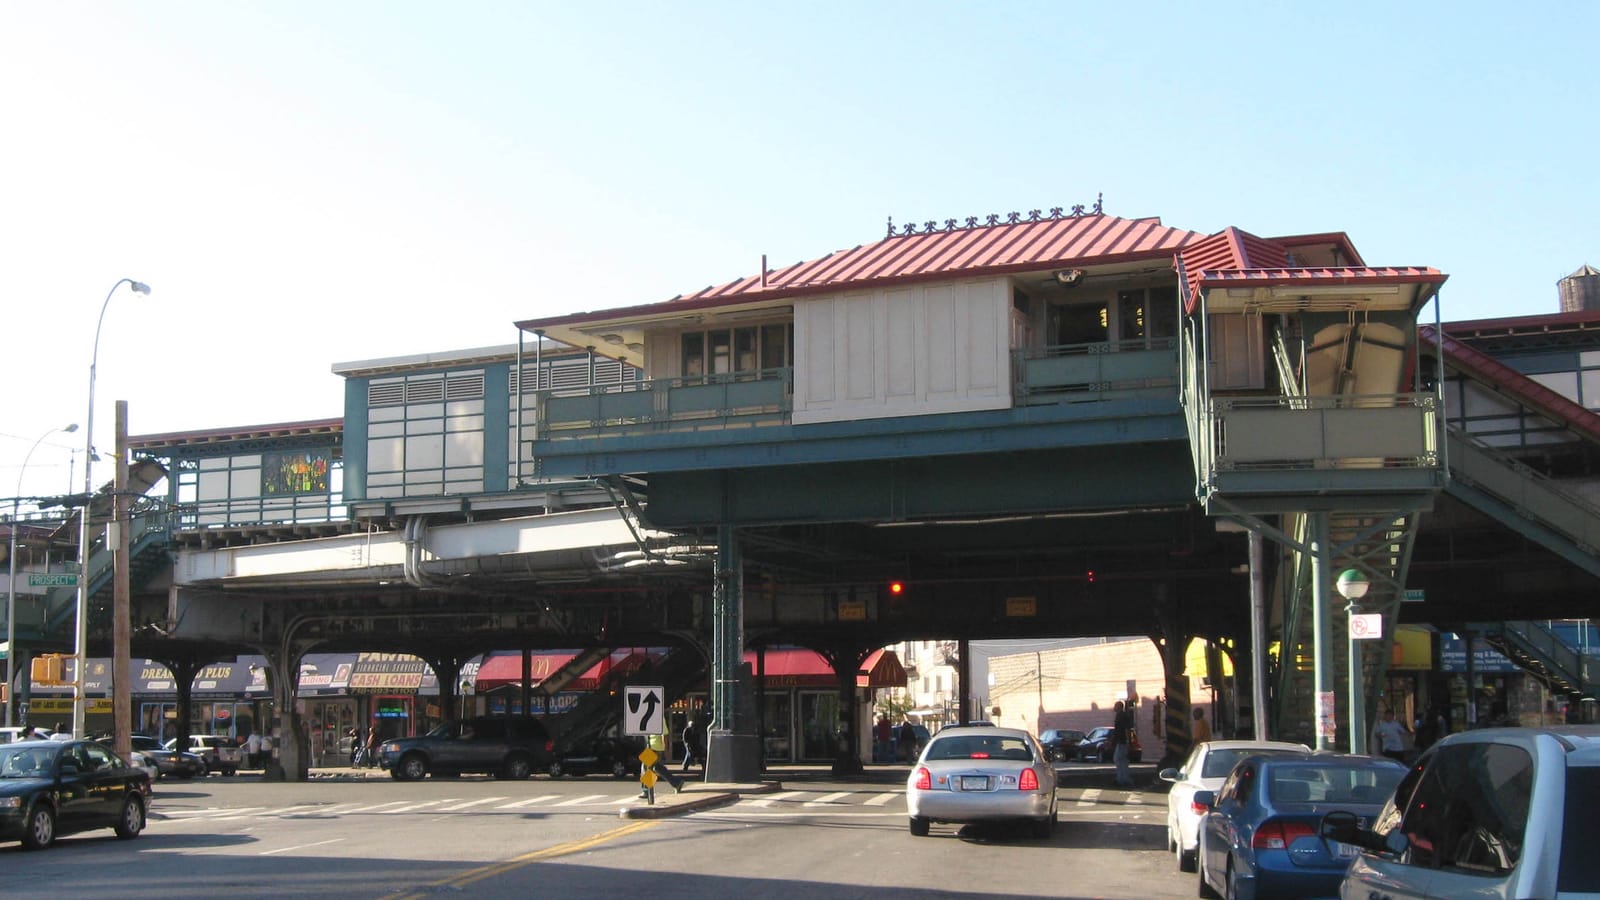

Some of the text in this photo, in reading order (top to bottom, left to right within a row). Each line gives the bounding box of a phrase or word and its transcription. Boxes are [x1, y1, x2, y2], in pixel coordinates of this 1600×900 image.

[30, 575, 69, 585] PROSPECT
[205, 667, 232, 678] PLUS
[351, 674, 381, 686] CASH
[384, 674, 420, 686] LOANS
